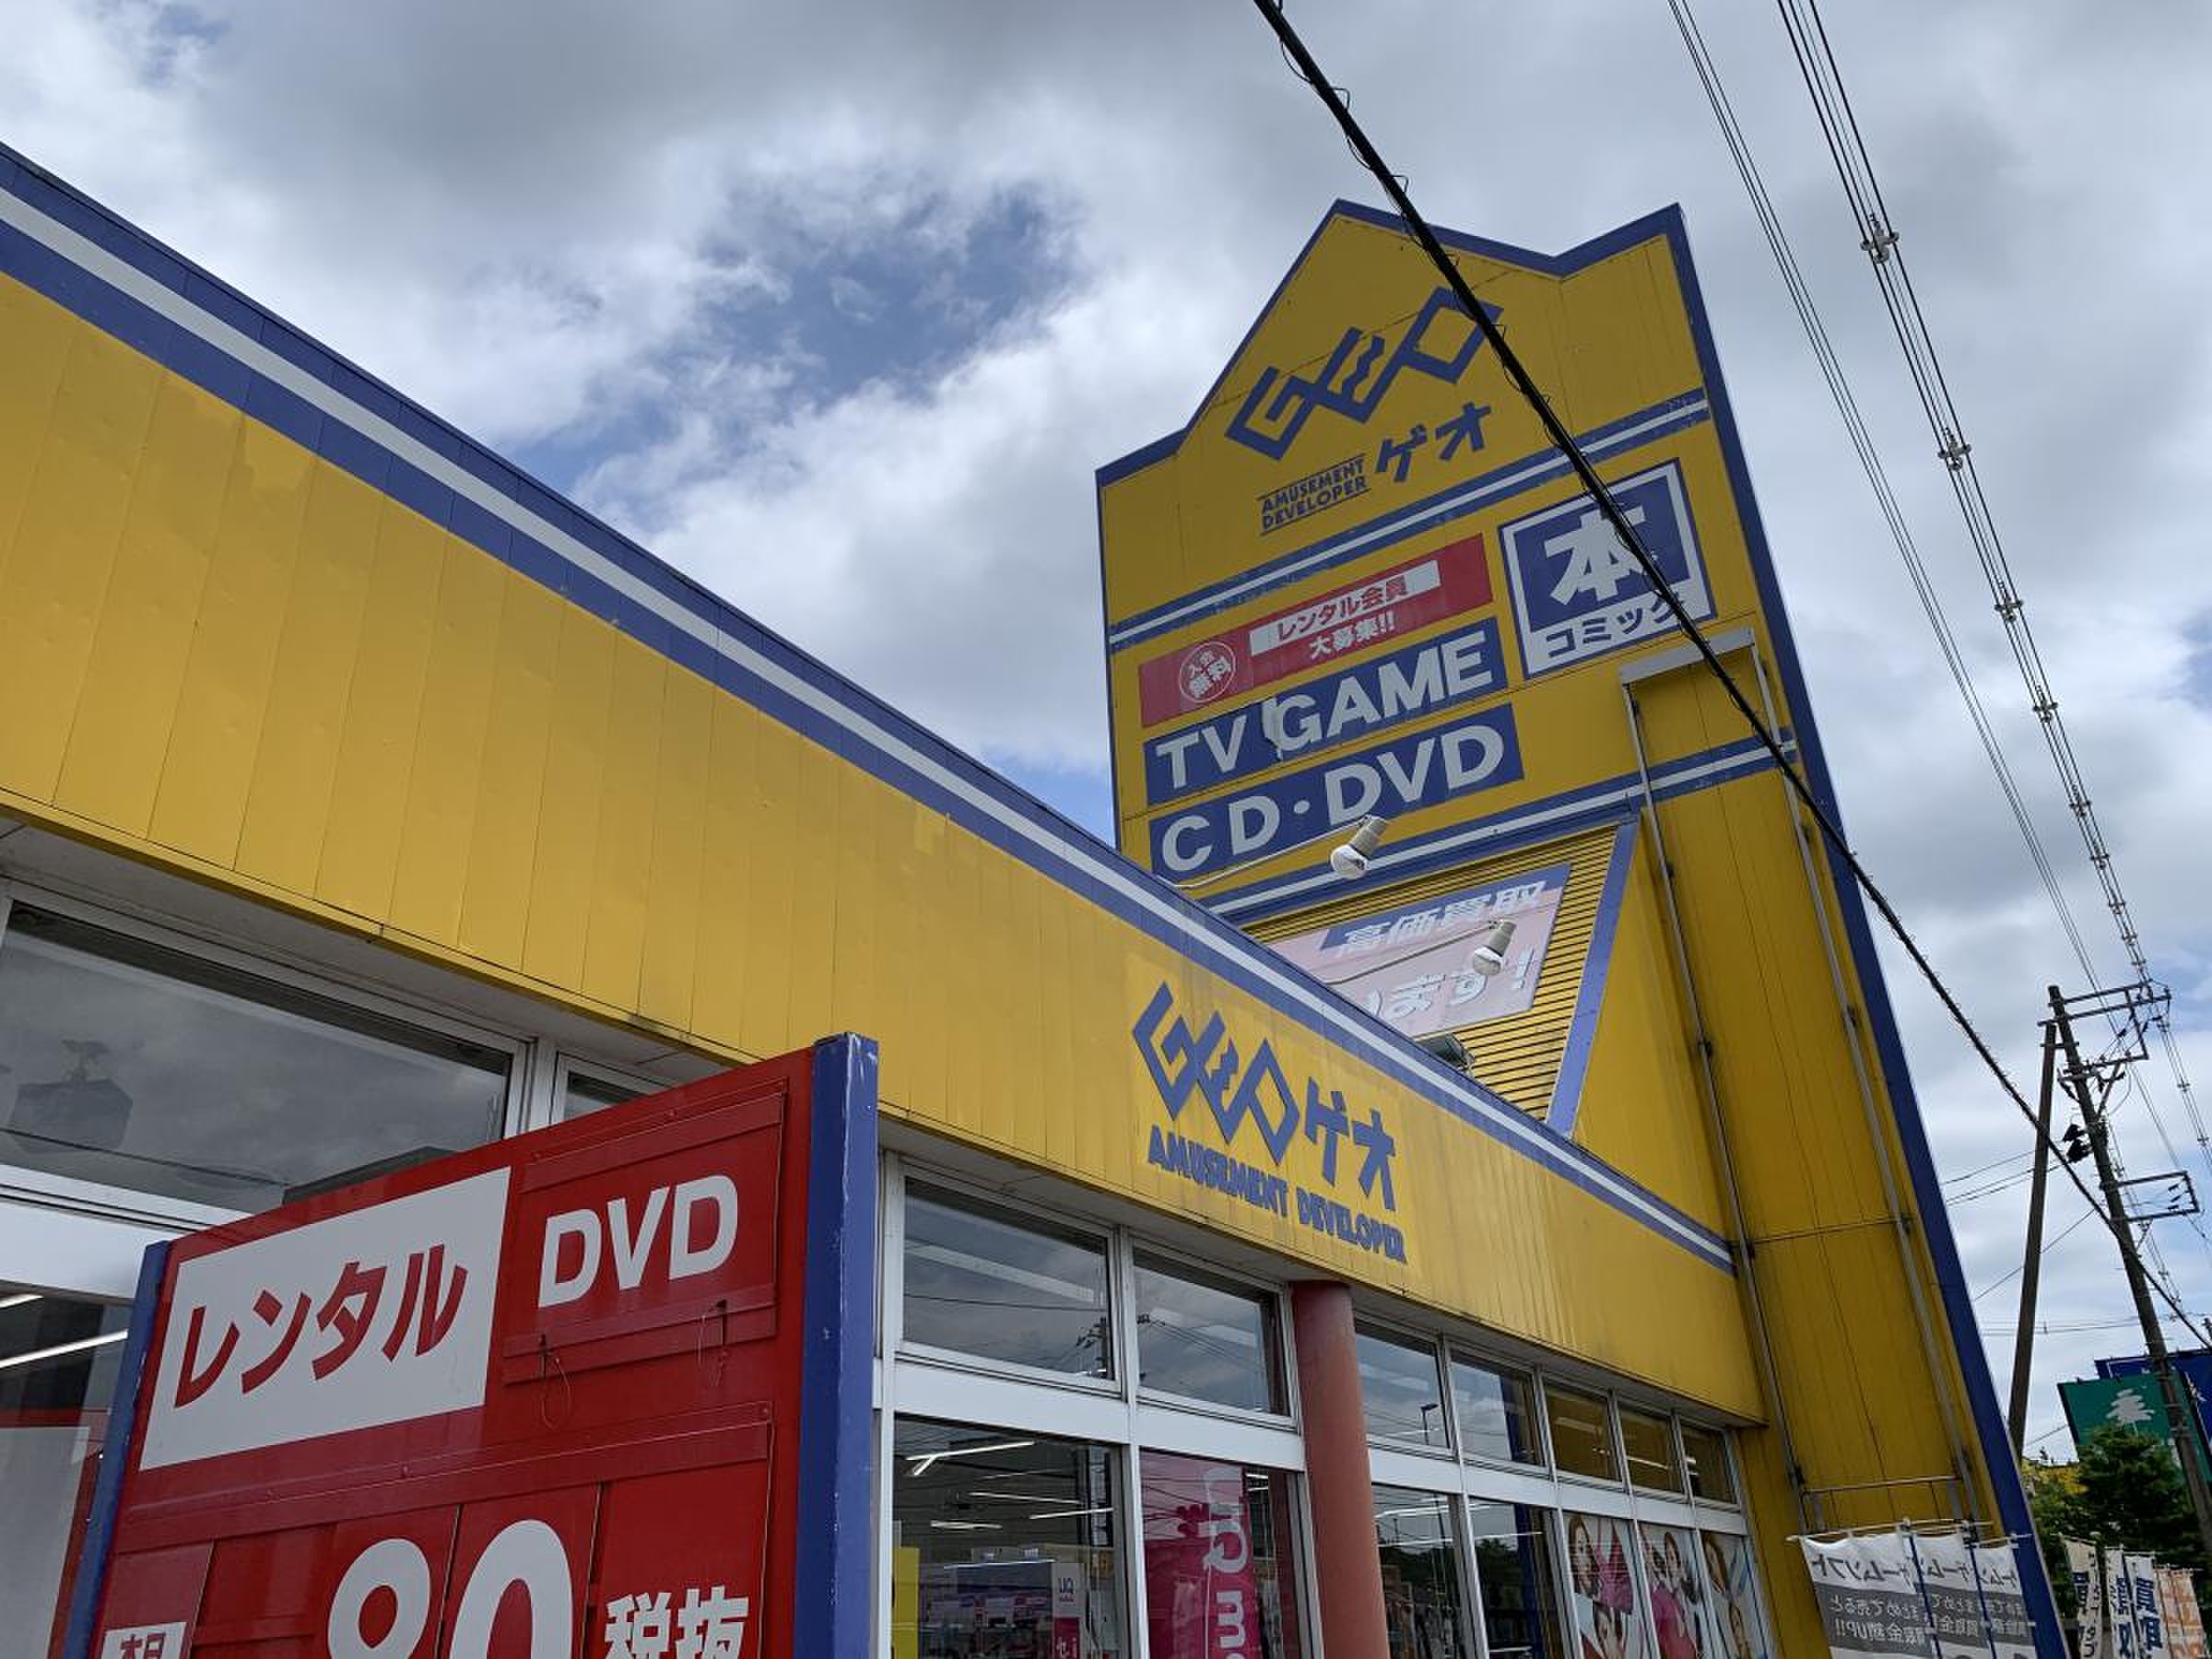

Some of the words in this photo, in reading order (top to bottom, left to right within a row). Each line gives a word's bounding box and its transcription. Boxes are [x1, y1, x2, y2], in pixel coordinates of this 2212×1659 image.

[1261, 458, 1366, 512] AMUSEMENT
[1374, 402, 1491, 483] ゲオ
[1263, 476, 1368, 531] DEVELOPER
[1544, 505, 1647, 606] 本
[1277, 575, 1408, 641] レンタル会員
[1546, 591, 1685, 658] コミック
[1156, 714, 1247, 790] TV
[1266, 630, 1493, 752] GAME
[1303, 1076, 1396, 1211] ゲオ
[1148, 1124, 1288, 1218] AMUSEMENT
[1296, 1186, 1407, 1265] DEVELOPER
[537, 1174, 739, 1311] DVD
[173, 1242, 469, 1409] レンタル
[604, 1585, 749, 1659] 税抜
